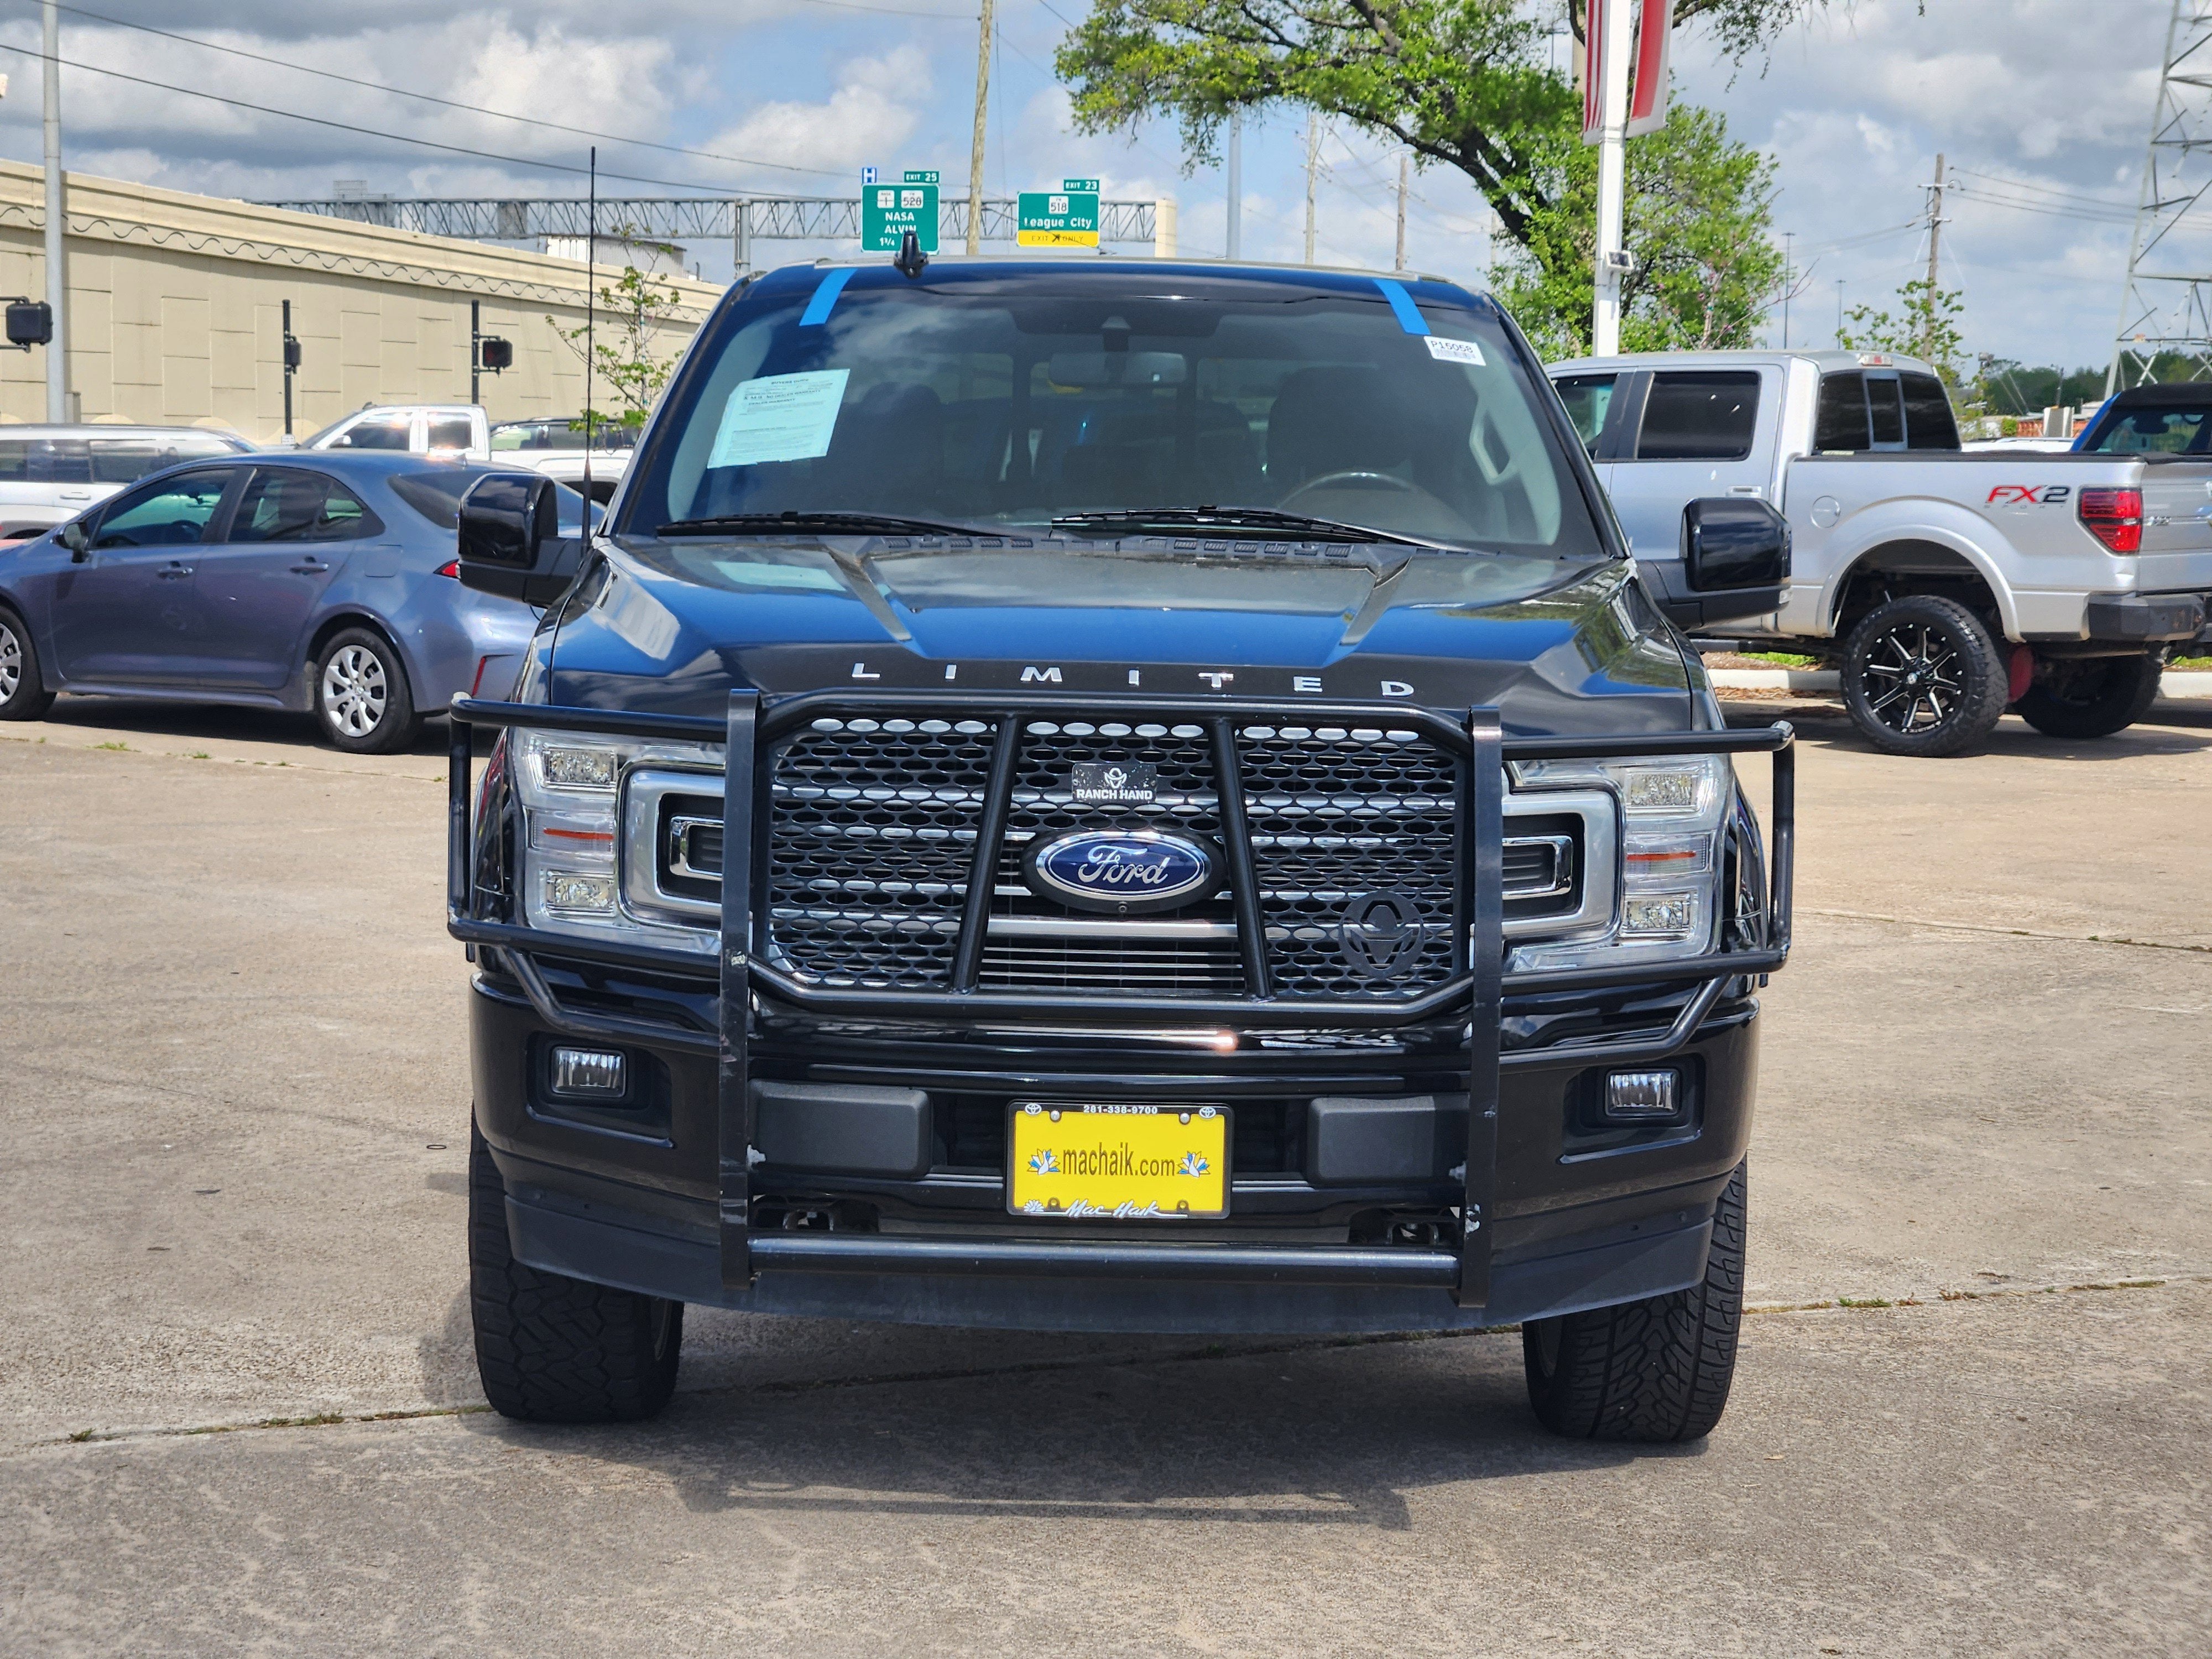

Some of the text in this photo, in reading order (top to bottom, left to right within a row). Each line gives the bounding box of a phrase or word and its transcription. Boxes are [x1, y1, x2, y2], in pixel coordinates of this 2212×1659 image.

[925, 173, 937, 181] 25
[1085, 181, 1097, 190] 23
[903, 197, 922, 206] 528
[1051, 202, 1067, 211] 518
[885, 212, 914, 221] NASA
[1024, 217, 1092, 229] League City
[885, 225, 916, 234] ALVIN
[1986, 484, 2071, 504] FX2
[852, 663, 1415, 697] LIMITED
[1076, 789, 1153, 800] RANCH HAND
[1078, 845, 1171, 884] Ford
[1083, 1105, 1158, 1115] 281-338-9700
[1062, 1142, 1175, 1176] machaik.com
[1063, 1198, 1108, 1218] Mac
